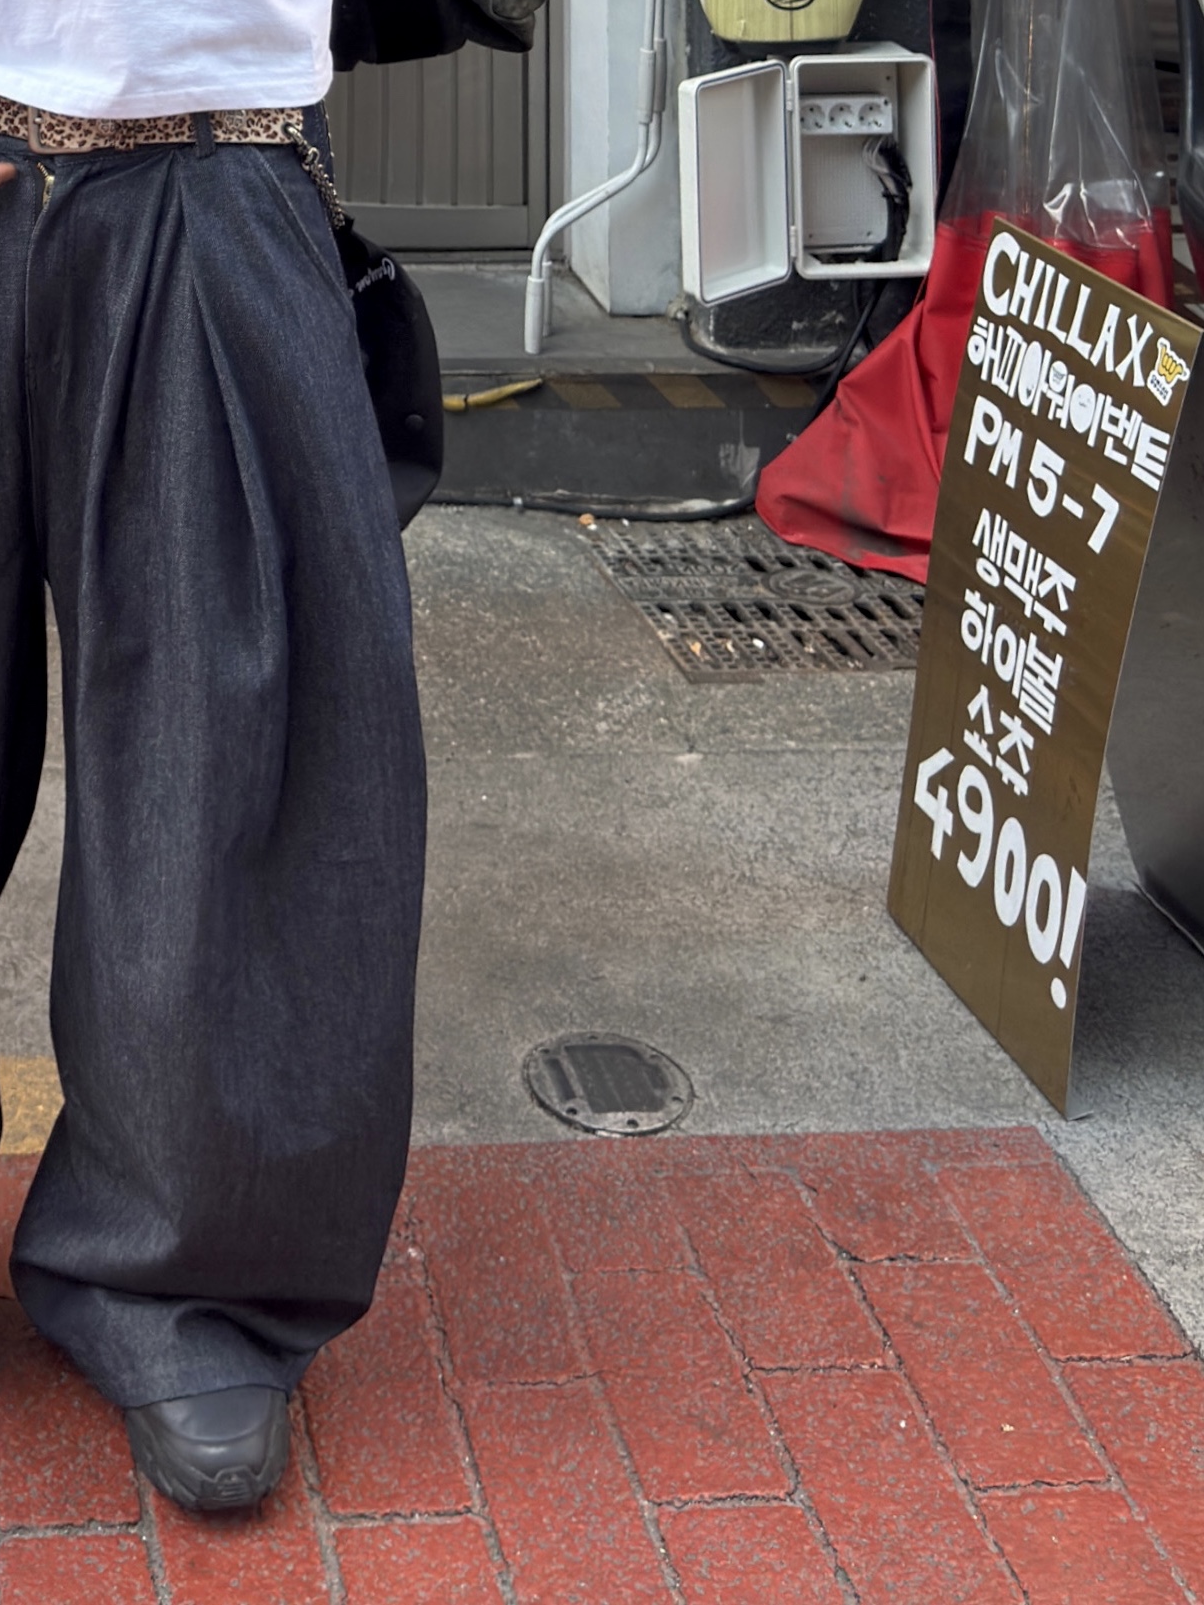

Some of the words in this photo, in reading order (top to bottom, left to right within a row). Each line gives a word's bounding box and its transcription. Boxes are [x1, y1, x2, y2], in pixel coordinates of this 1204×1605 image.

[982, 230, 1154, 388] CHILLAX
[964, 395, 1024, 489] PM
[972, 507, 1076, 636] 생맥주
[960, 588, 1064, 735] 하이볼
[963, 684, 1034, 796] 소주
[914, 747, 1087, 1010] 4900!
